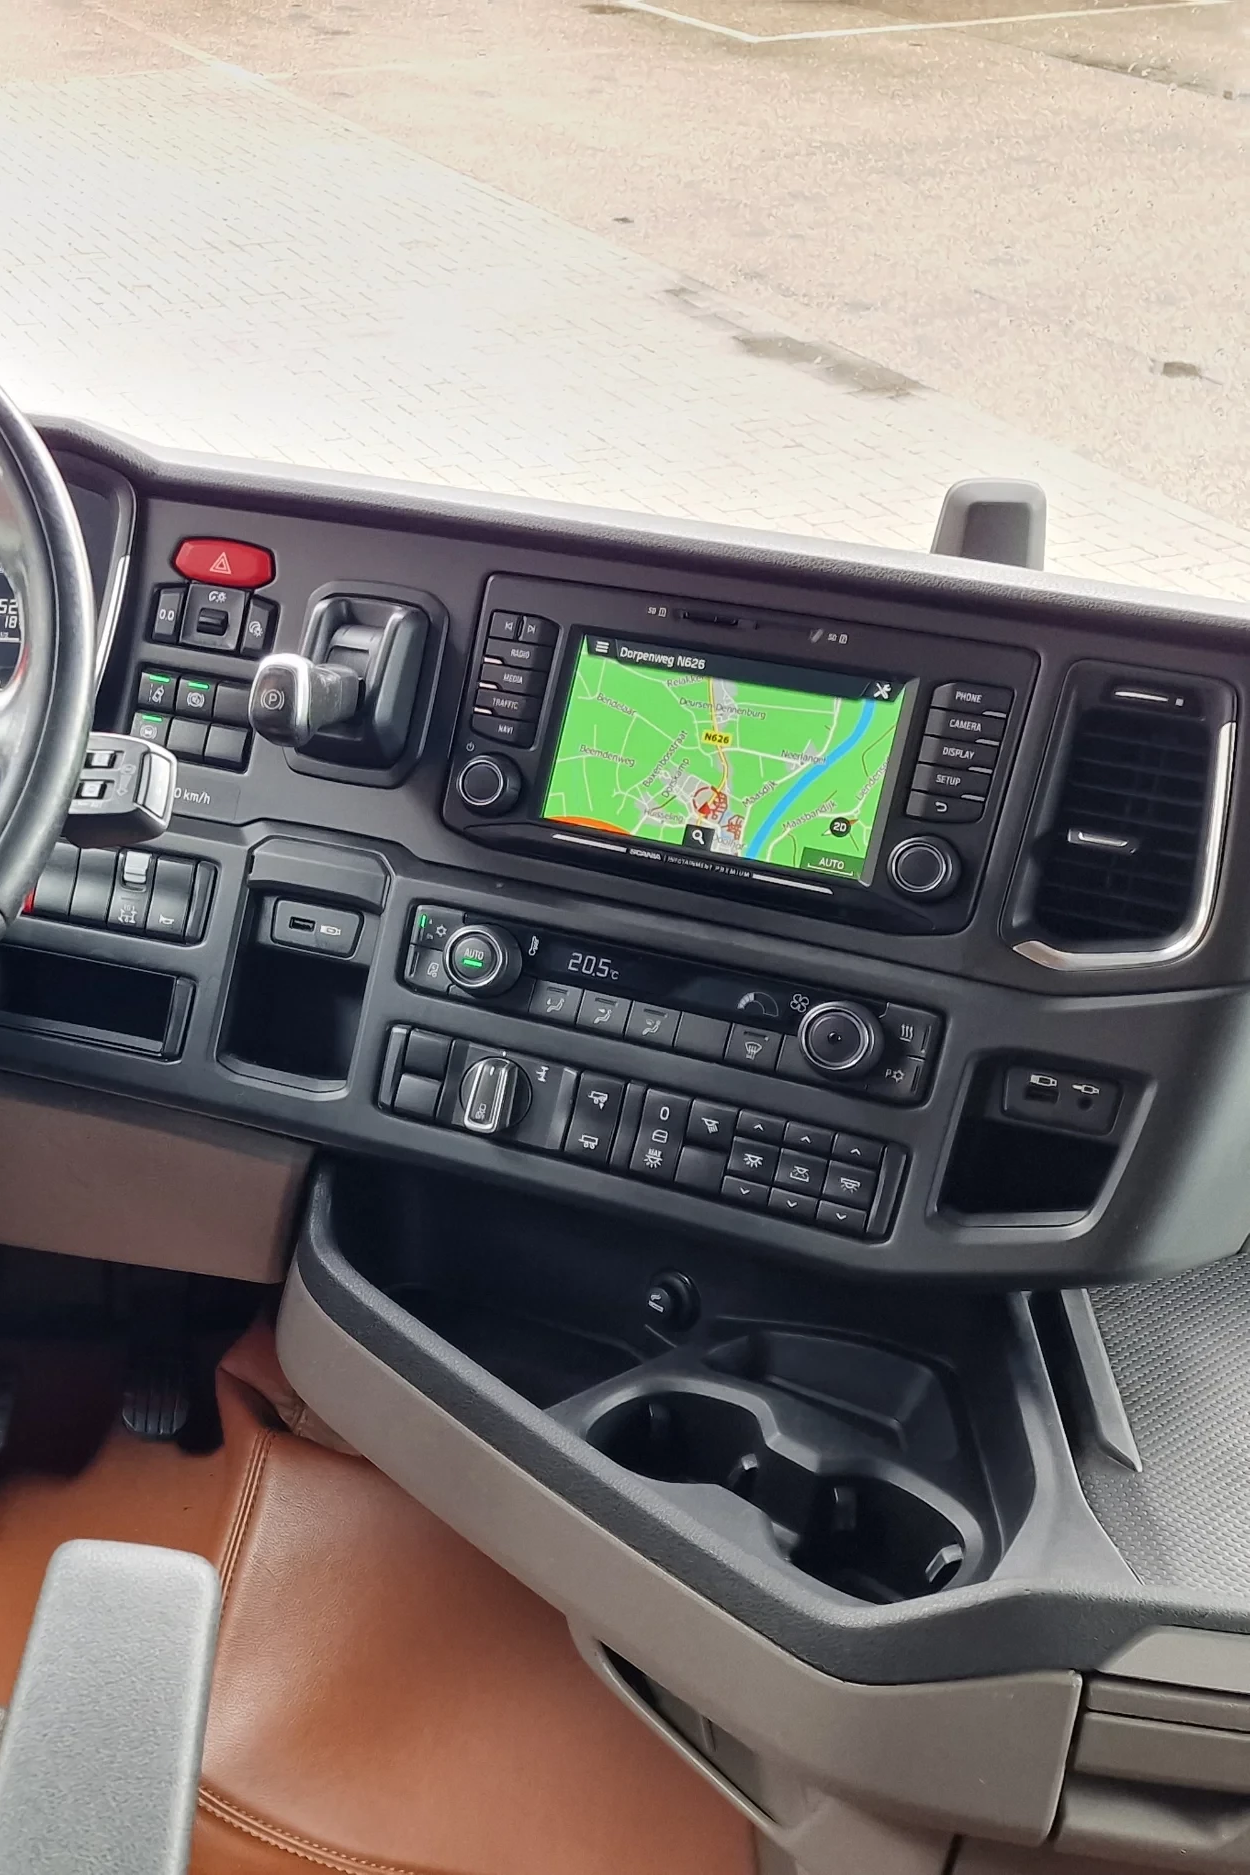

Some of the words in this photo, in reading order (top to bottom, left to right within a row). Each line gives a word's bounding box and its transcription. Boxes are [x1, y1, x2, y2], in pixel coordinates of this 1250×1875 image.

[510, 648, 530, 660] RADIO
[620, 646, 675, 668] Dorpenweg
[677, 655, 706, 670] N626
[503, 673, 523, 684] MEDIA
[955, 690, 982, 703] PHONE
[492, 697, 519, 710] TRAFFIC
[498, 724, 513, 735] NAVI
[949, 718, 982, 732] CAMERA
[704, 732, 730, 744] N626
[942, 746, 975, 760] DISPLAY
[935, 774, 961, 787] SETUP
[183, 788, 211, 805] km/h
[742, 780, 778, 807] Maasdijk
[833, 822, 848, 833] 2D
[630, 848, 662, 861] SCANIA
[819, 857, 845, 870] AUTO
[464, 947, 484, 960] AUTO
